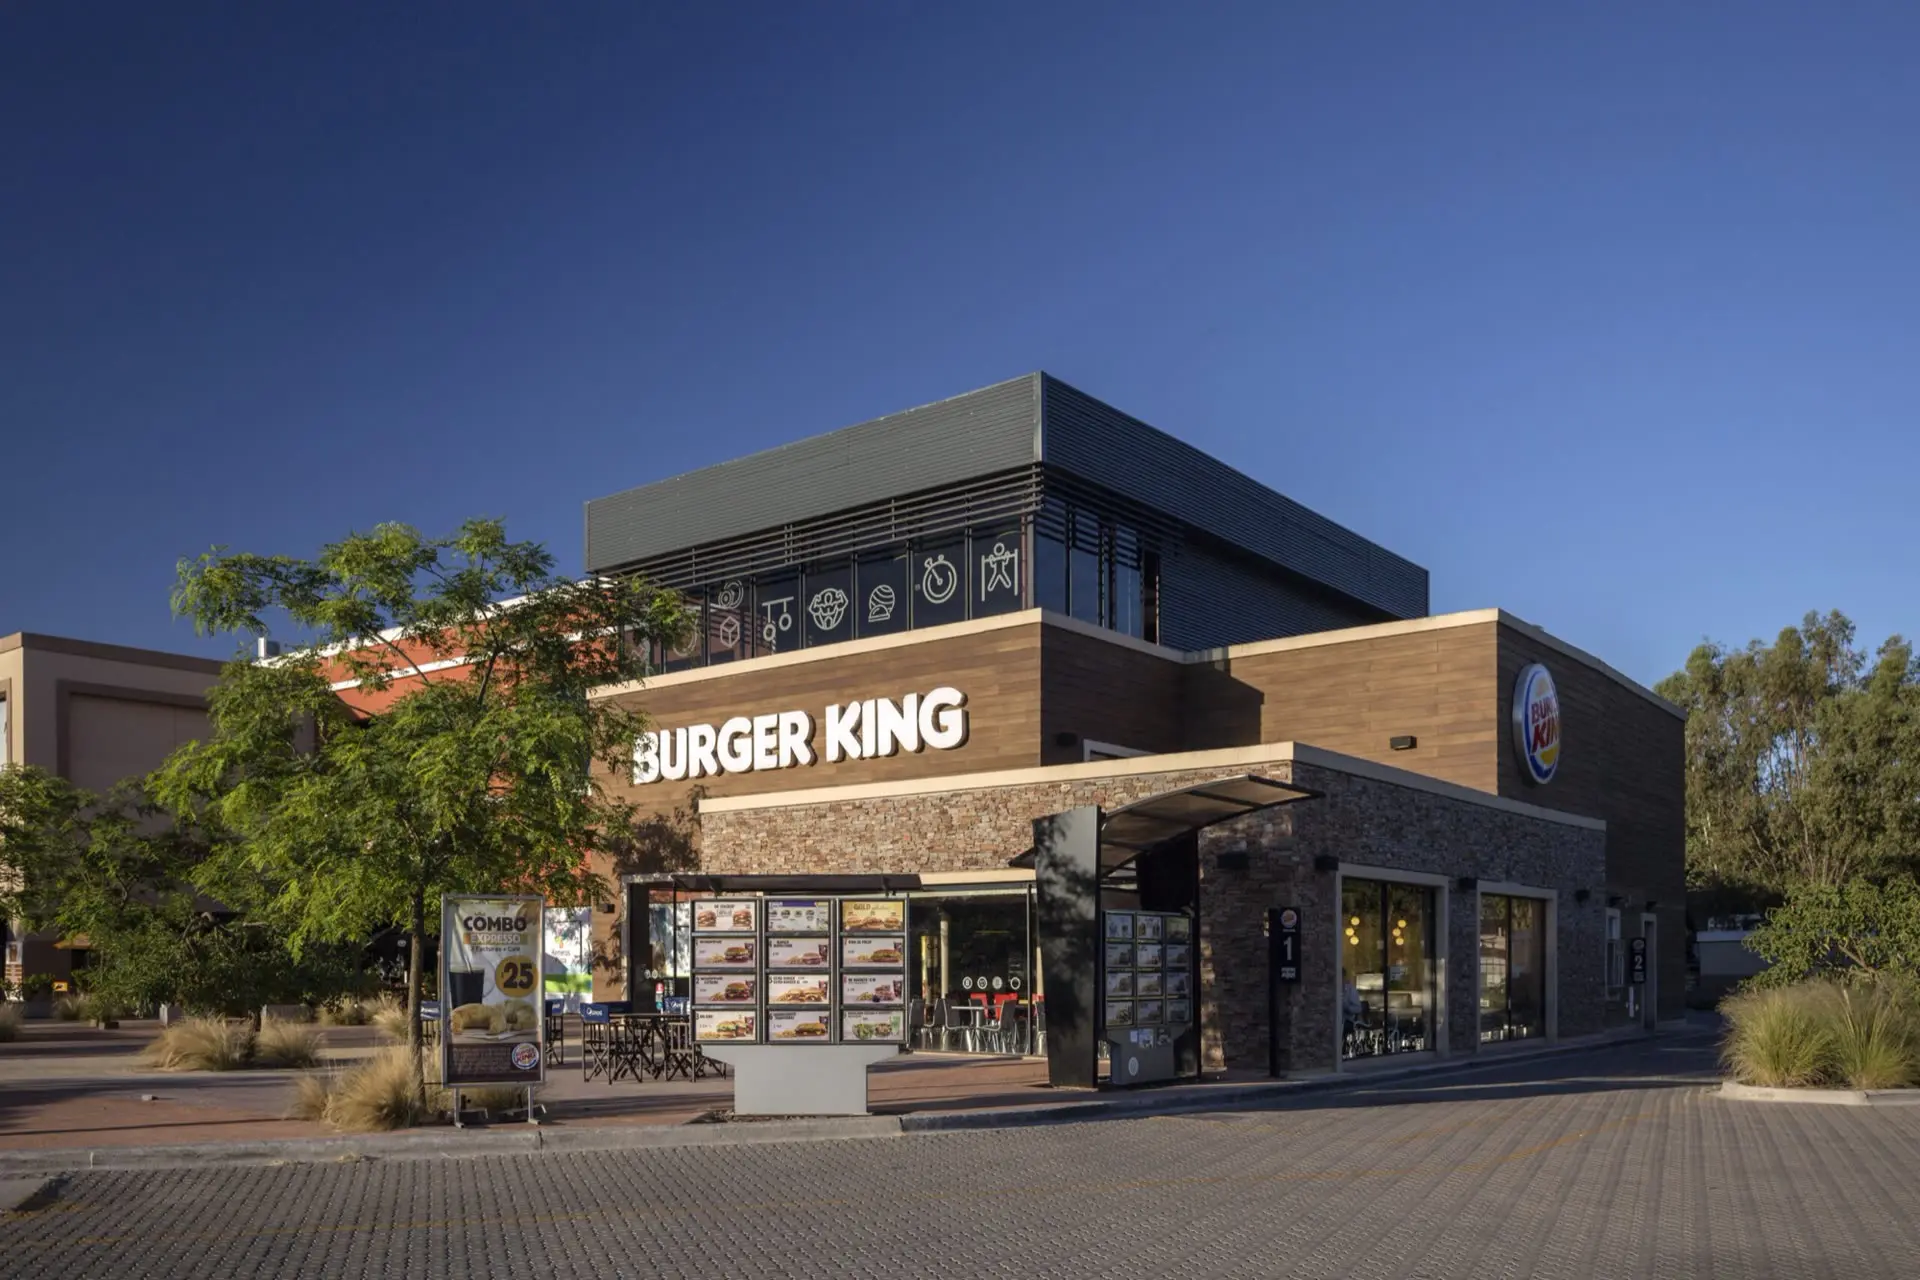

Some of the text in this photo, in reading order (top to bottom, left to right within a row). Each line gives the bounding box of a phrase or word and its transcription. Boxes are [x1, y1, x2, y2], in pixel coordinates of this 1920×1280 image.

[633, 686, 969, 785] BURGER KING
[463, 916, 527, 932] COMBO
[471, 933, 520, 943] EXPRESSO
[1283, 936, 1293, 961] 1
[1634, 955, 1643, 969] 2
[503, 962, 534, 990] 25
